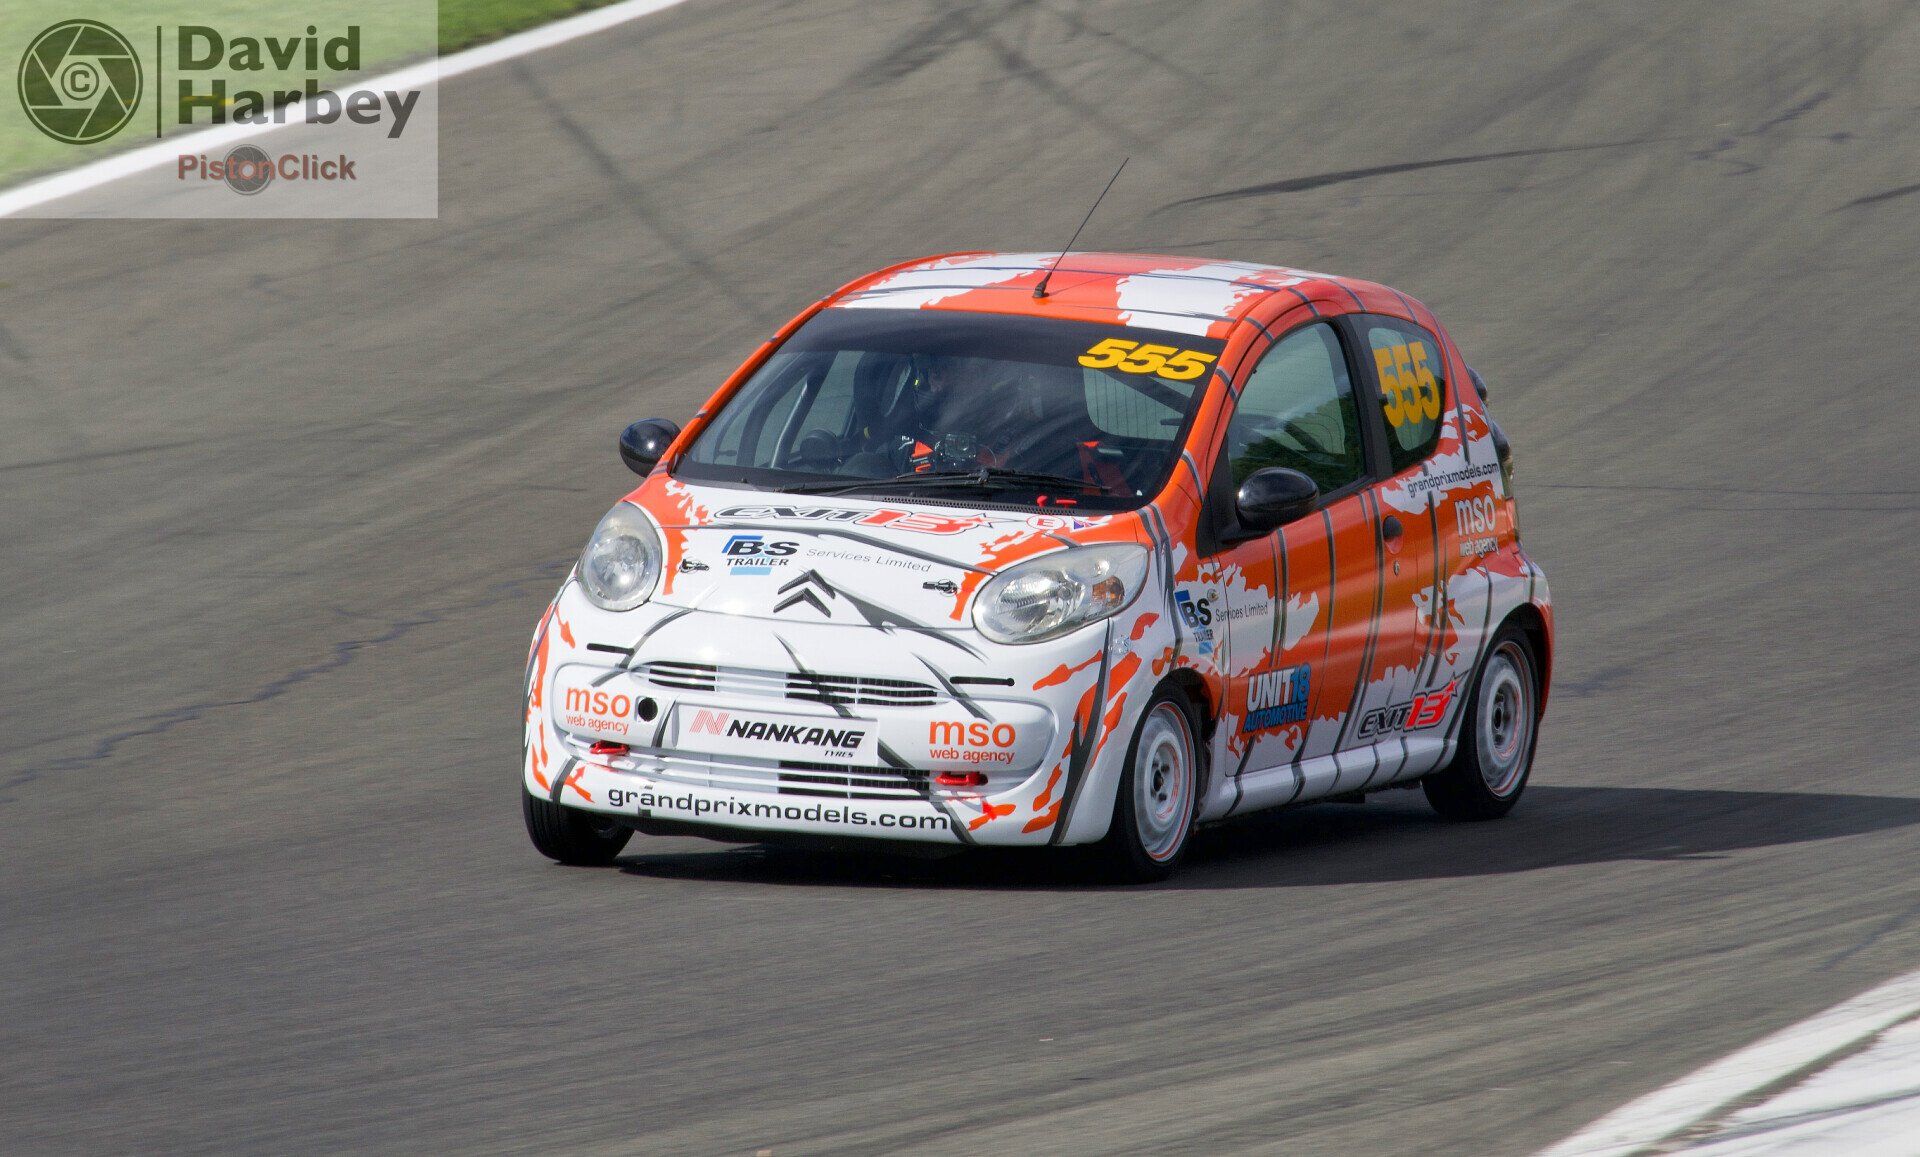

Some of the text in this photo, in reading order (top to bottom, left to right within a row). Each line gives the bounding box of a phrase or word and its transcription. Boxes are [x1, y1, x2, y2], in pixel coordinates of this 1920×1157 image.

[1077, 338, 1218, 381] 555
[1372, 341, 1441, 428] 555
[1407, 462, 1499, 498] grandprixmodels.com
[1454, 494, 1496, 537] mso
[726, 558, 790, 567] TRAILER
[806, 548, 932, 573] Services Limited
[1215, 601, 1269, 622] Services Limited
[566, 687, 631, 718] mso
[566, 714, 629, 735] web agency
[726, 719, 866, 749] NANKANG
[928, 720, 1016, 748] mso
[824, 750, 854, 758] TYRES
[930, 747, 1015, 765] web agency
[607, 787, 948, 829] grandprixmodels.com
